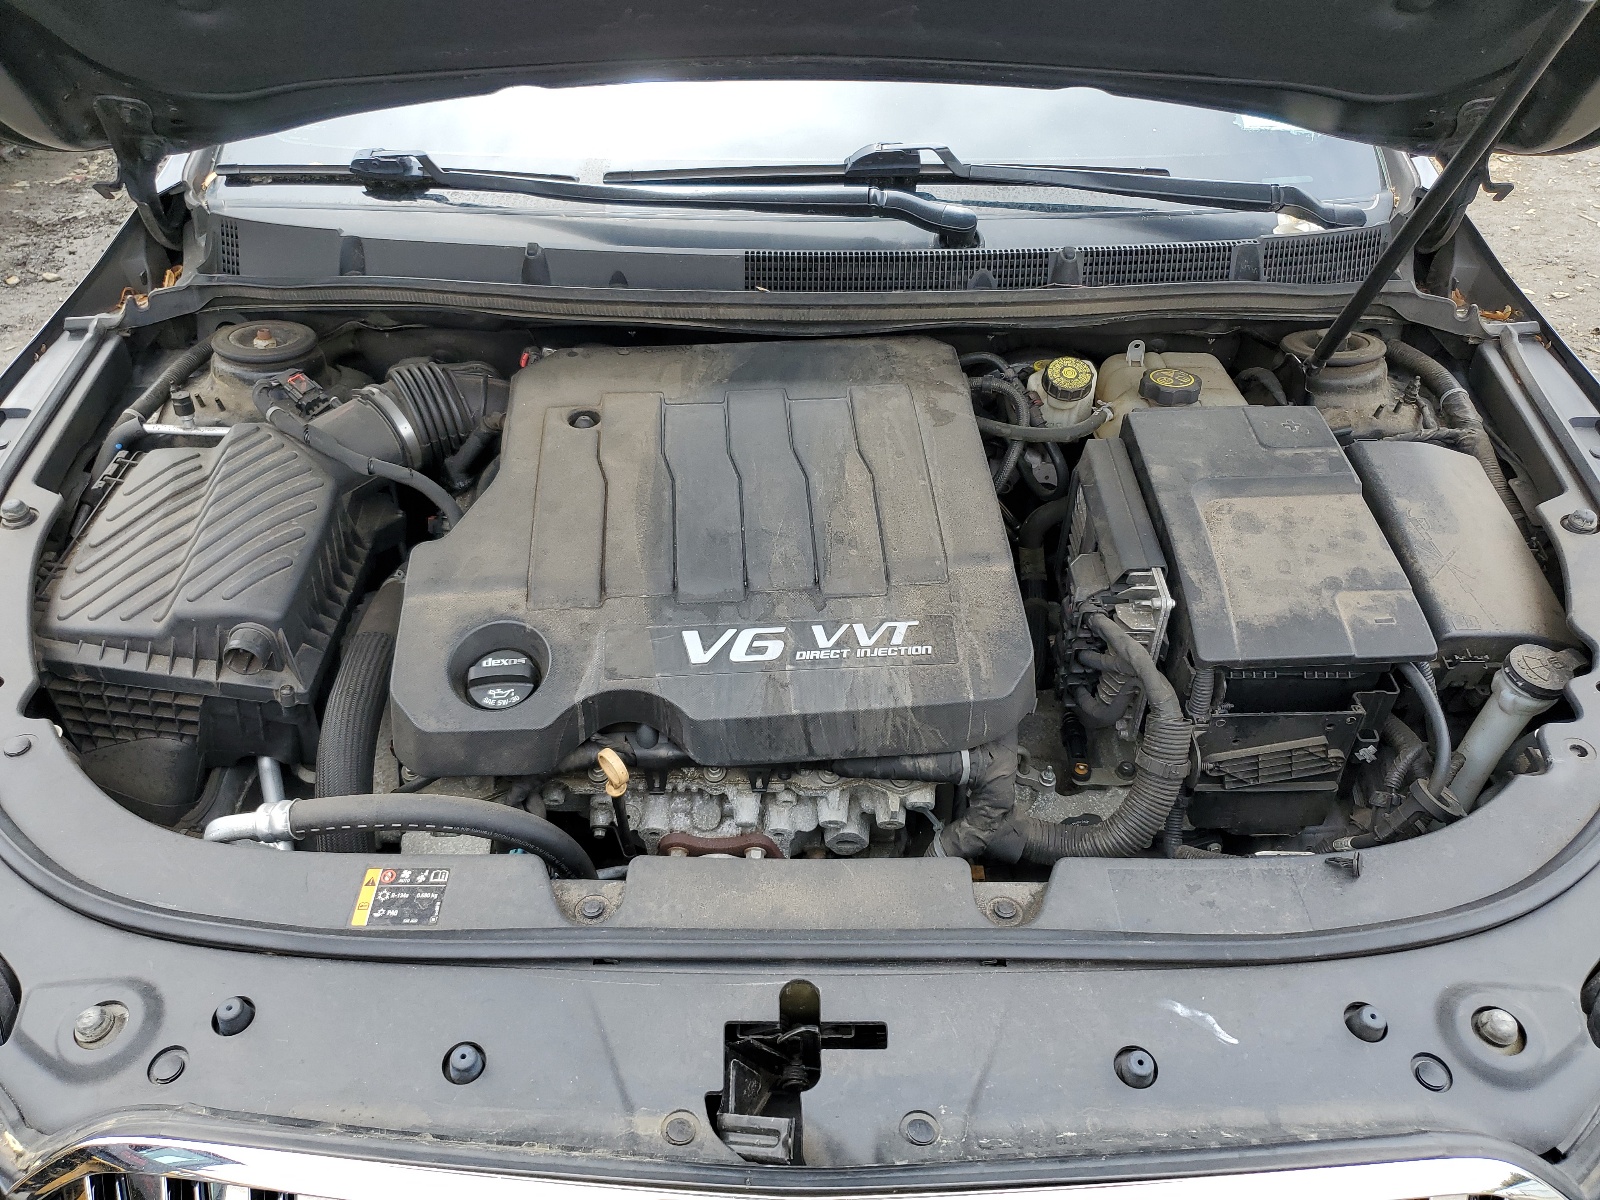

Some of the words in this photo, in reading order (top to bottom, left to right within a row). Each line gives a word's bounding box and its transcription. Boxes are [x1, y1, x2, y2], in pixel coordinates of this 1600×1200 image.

[681, 626, 787, 665] V6
[811, 620, 920, 649] VVT
[795, 649, 850, 661] DIRECT
[856, 645, 932, 658] INJECTION
[482, 657, 527, 667] dexos
[483, 696, 497, 706] SAE
[497, 695, 520, 706] 5W-30
